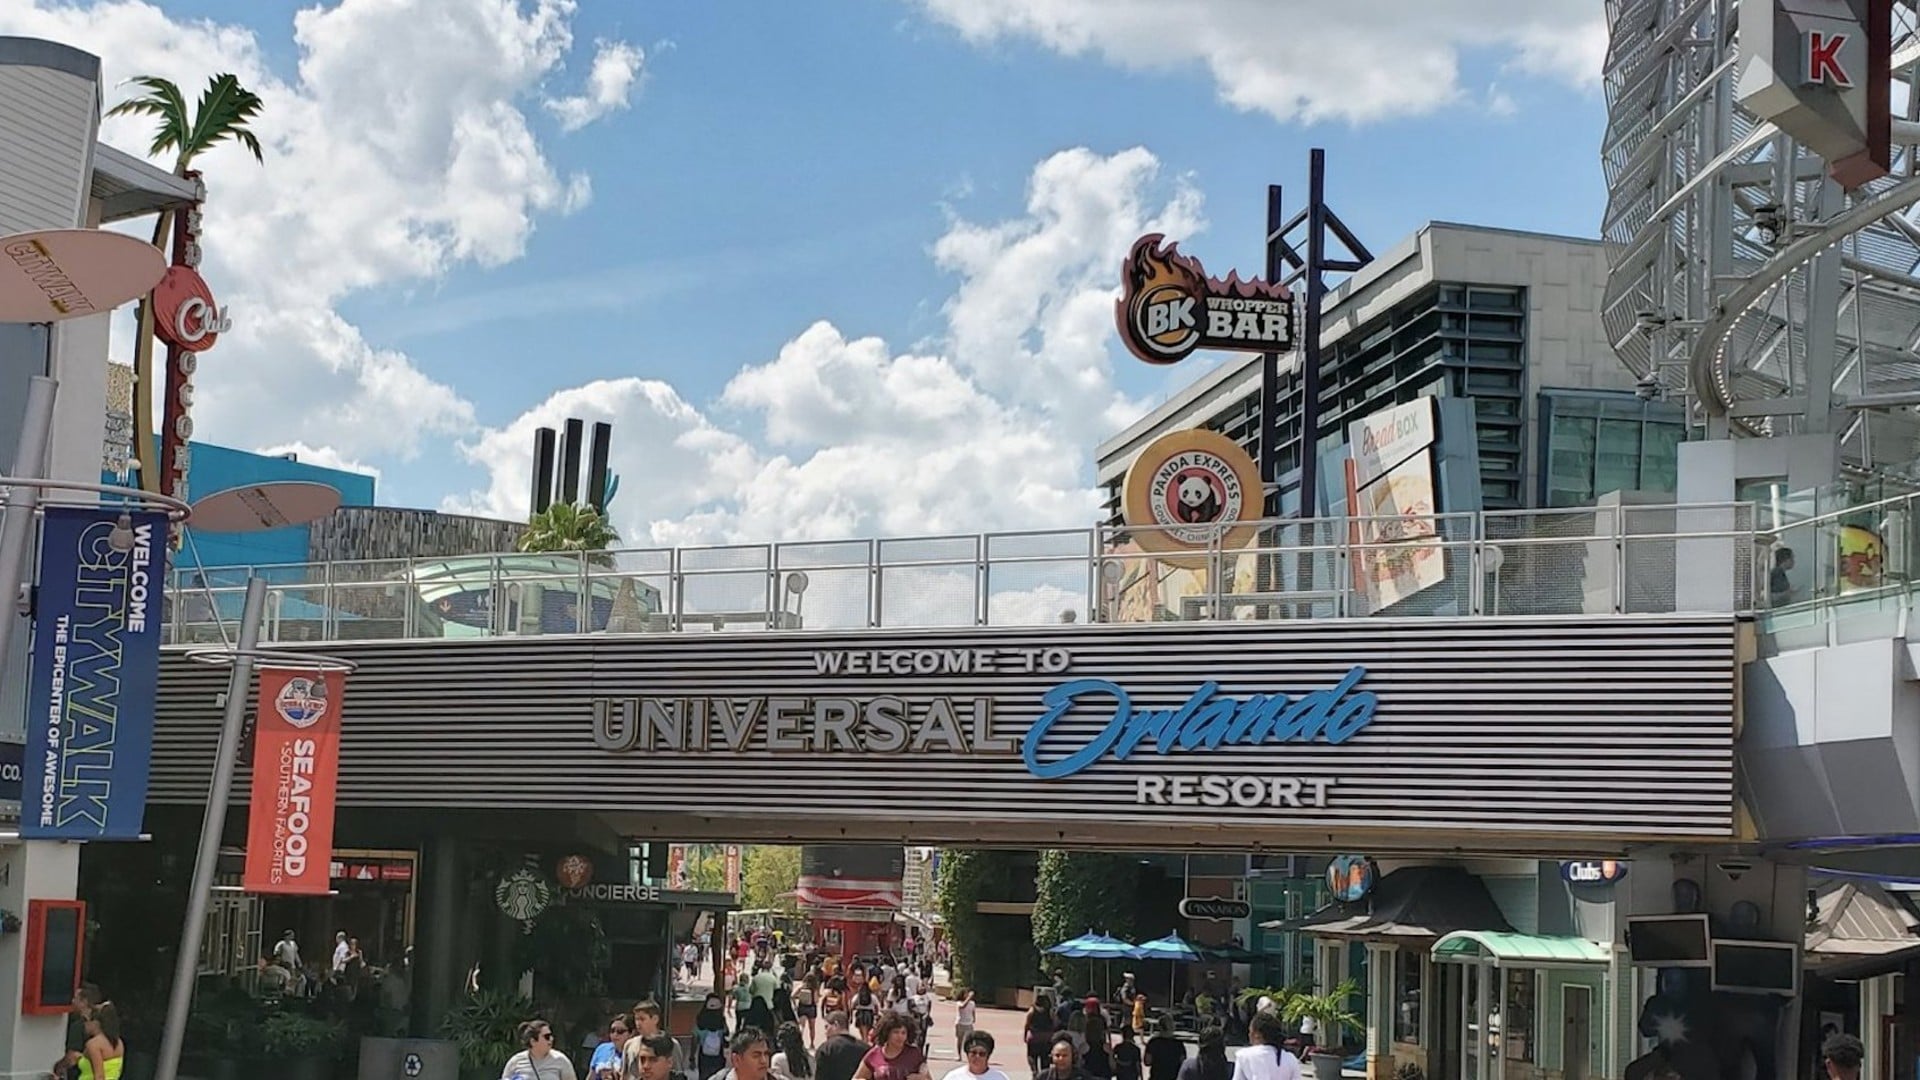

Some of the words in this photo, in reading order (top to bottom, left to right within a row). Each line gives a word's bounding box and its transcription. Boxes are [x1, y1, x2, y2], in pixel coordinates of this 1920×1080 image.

[1808, 29, 1853, 88] K
[175, 297, 232, 342] Club
[1147, 297, 1196, 337] BK
[1206, 297, 1289, 314] WHOPPER
[1206, 310, 1289, 342] BAR
[1153, 456, 1190, 497] PANDA
[1194, 454, 1240, 500] EXPRESS
[128, 523, 152, 633] WELCOME
[56, 614, 70, 644] THE
[49, 645, 67, 724] EPICENTER
[57, 521, 128, 830] CITYWALK
[813, 650, 998, 675] WELCOME
[1017, 648, 1072, 673] TO
[47, 727, 60, 749] OF
[592, 695, 1020, 753] UNIVERSAL
[1022, 665, 1379, 779] Orlando
[40, 750, 58, 828] AWESOME
[277, 746, 293, 815] SOUTHERN
[1136, 774, 1337, 807] RESORT
[284, 738, 316, 877] SEAFOOD
[270, 817, 287, 885] FAVORITES
[1569, 861, 1602, 881] Clubs
